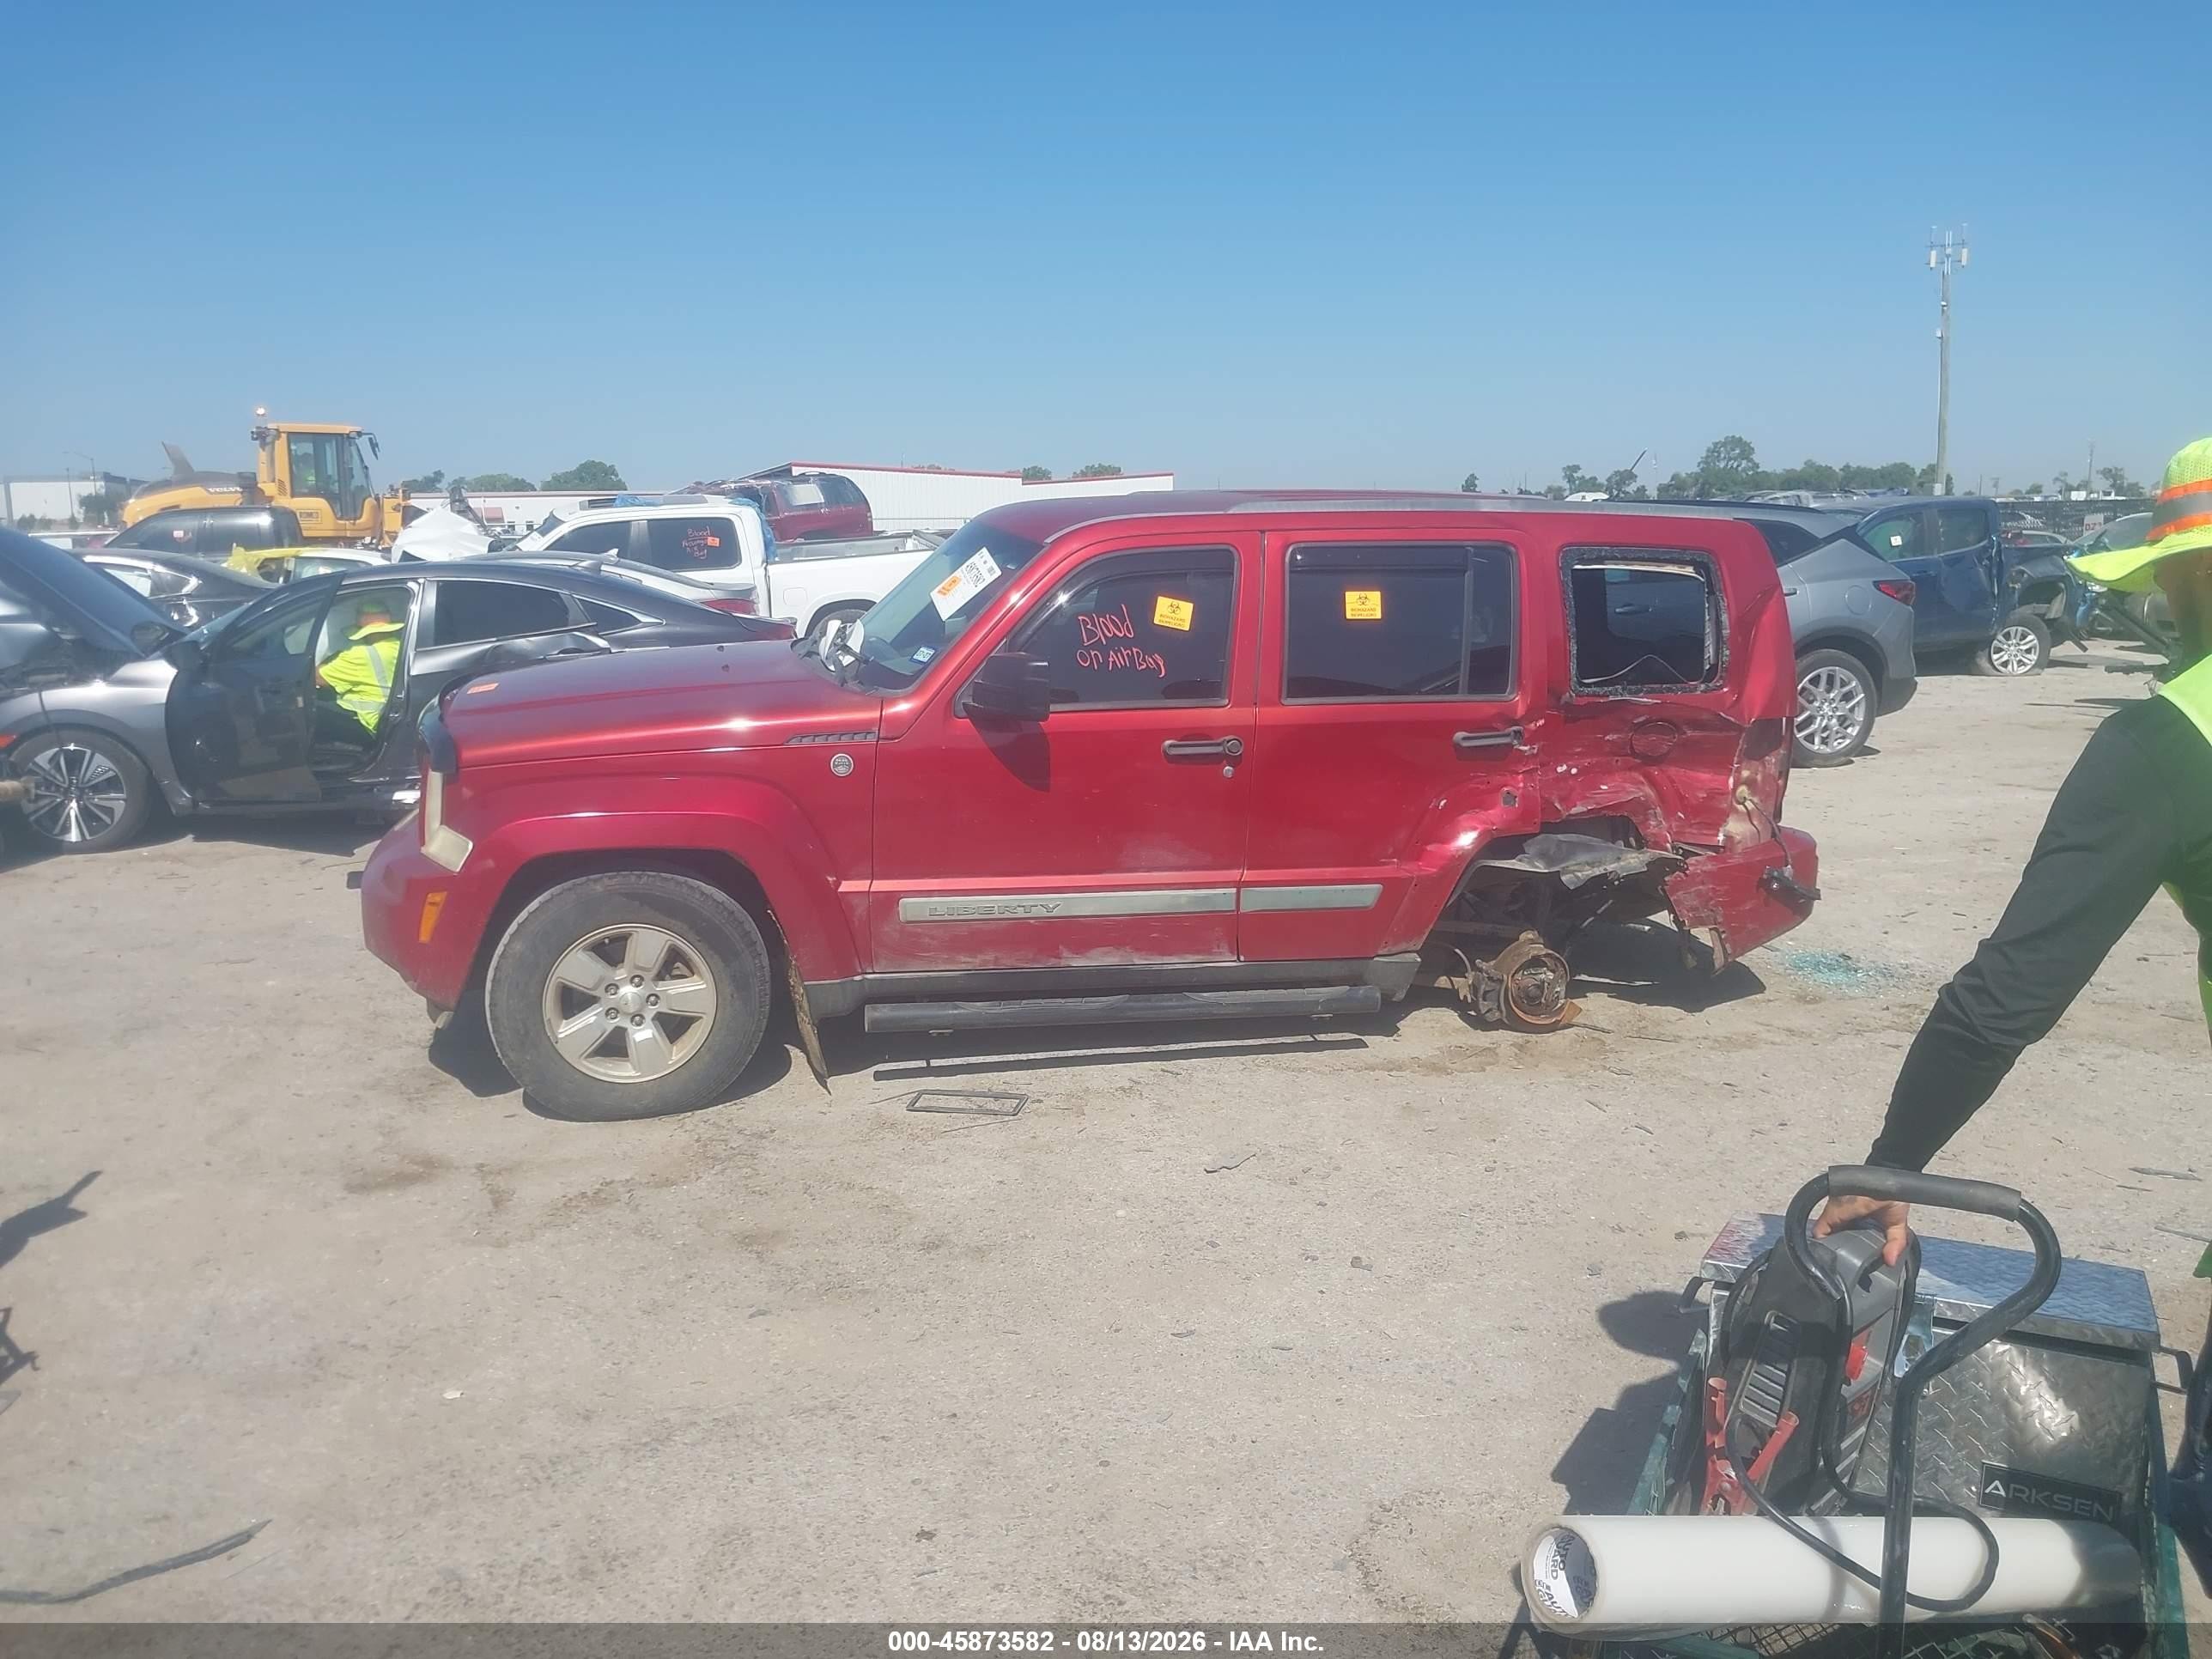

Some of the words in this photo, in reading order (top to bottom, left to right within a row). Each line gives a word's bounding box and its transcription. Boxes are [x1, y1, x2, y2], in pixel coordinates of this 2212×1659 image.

[1078, 604, 1134, 646] Blood
[928, 902, 1062, 916] LIBERTY
[1984, 1480, 2113, 1522] ARKSEN
[1544, 1591, 1568, 1617] AUT
